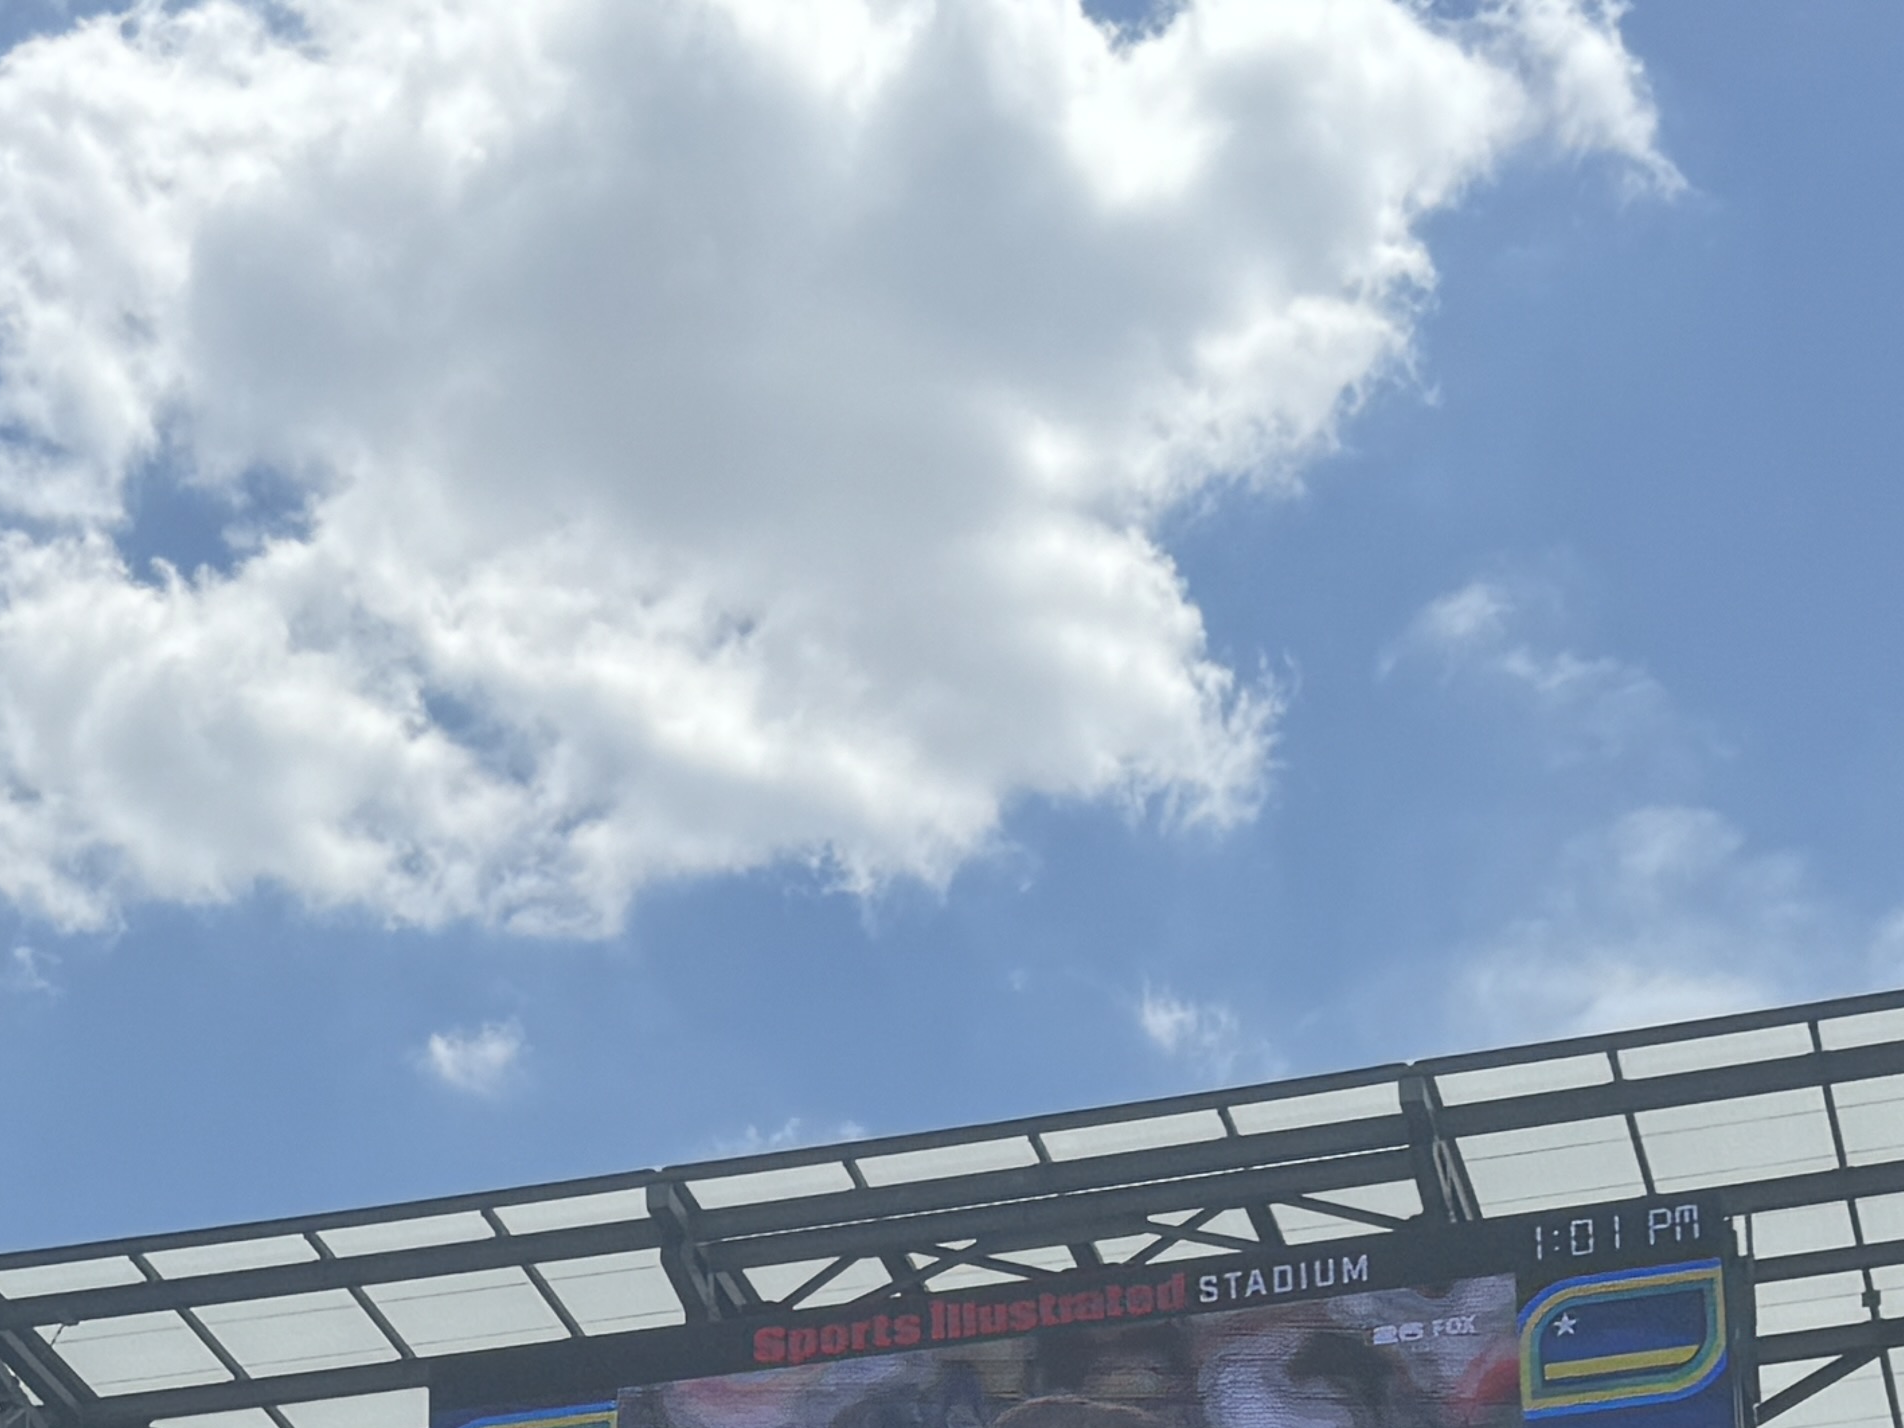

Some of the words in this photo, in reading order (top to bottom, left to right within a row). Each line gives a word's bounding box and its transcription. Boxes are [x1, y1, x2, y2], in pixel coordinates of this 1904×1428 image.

[1535, 1215, 1620, 1261] 1:01
[1648, 1205, 1700, 1246] PM
[753, 1311, 922, 1365] Sports
[928, 1272, 1188, 1341] Illustrated
[1198, 1254, 1370, 1304] STADIUM
[1431, 1313, 1477, 1337] FOX
